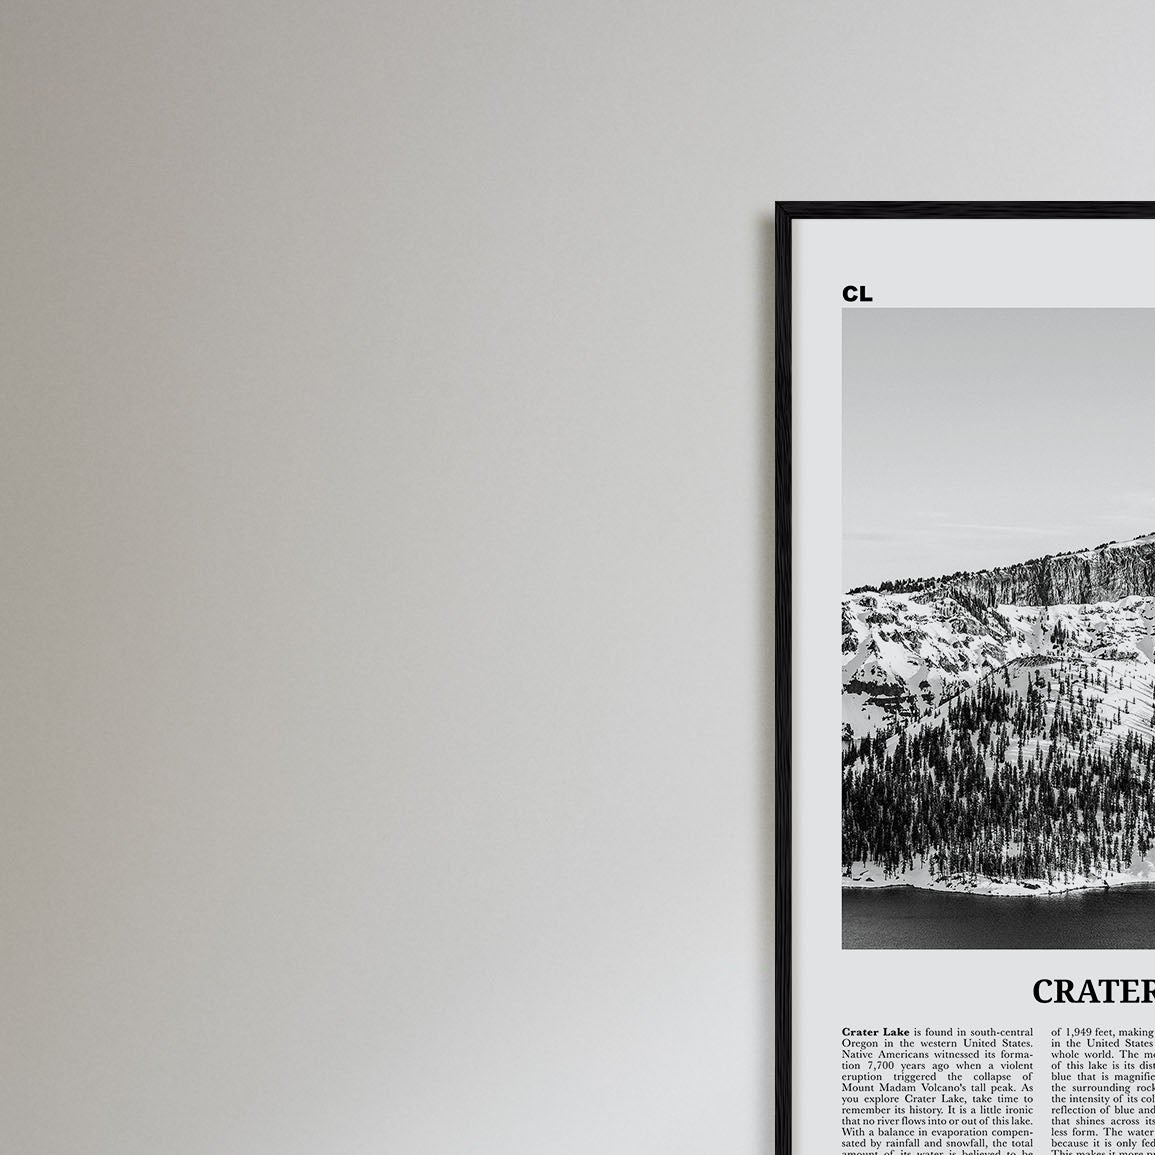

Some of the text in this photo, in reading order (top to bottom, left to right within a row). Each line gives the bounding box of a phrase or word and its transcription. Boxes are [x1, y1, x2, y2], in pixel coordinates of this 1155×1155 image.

[842, 284, 874, 303] CL
[842, 1027, 1033, 1037] Crater Lake is found in south-central
[1051, 1027, 1061, 1037] of
[1067, 1027, 1092, 1038] 1,949
[1095, 1027, 1116, 1038] feet,
[1118, 1027, 1154, 1039] making
[841, 1038, 1033, 1050] Oregon in the western United States.
[842, 1049, 1033, 1059] Native Americans witnessed its forma-
[1051, 1049, 1079, 1059] whole
[1084, 1049, 1114, 1059] world.
[1119, 1049, 1139, 1059] The
[841, 1072, 1032, 1084] eruption triggered the collapse of
[842, 1083, 1033, 1095] Mount Madam Volcano's tall peak. As
[1051, 1083, 1066, 1092] the
[1072, 1083, 1131, 1095] surrounding
[842, 1105, 1033, 1117] remember its history. It is a little ironic
[1051, 1105, 1096, 1115] reflection
[1099, 1105, 1110, 1115] of
[1114, 1105, 1135, 1115] blue
[1138, 1105, 1155, 1115] and
[842, 1127, 865, 1137] With
[878, 1127, 915, 1137] balance
[918, 1127, 928, 1137] in
[931, 1127, 988, 1139] evaporation
[991, 1130, 1033, 1139] compen-
[1051, 1127, 1068, 1137] less
[1072, 1127, 1098, 1137] form.
[1103, 1127, 1123, 1137] The
[1127, 1129, 1154, 1137] water
